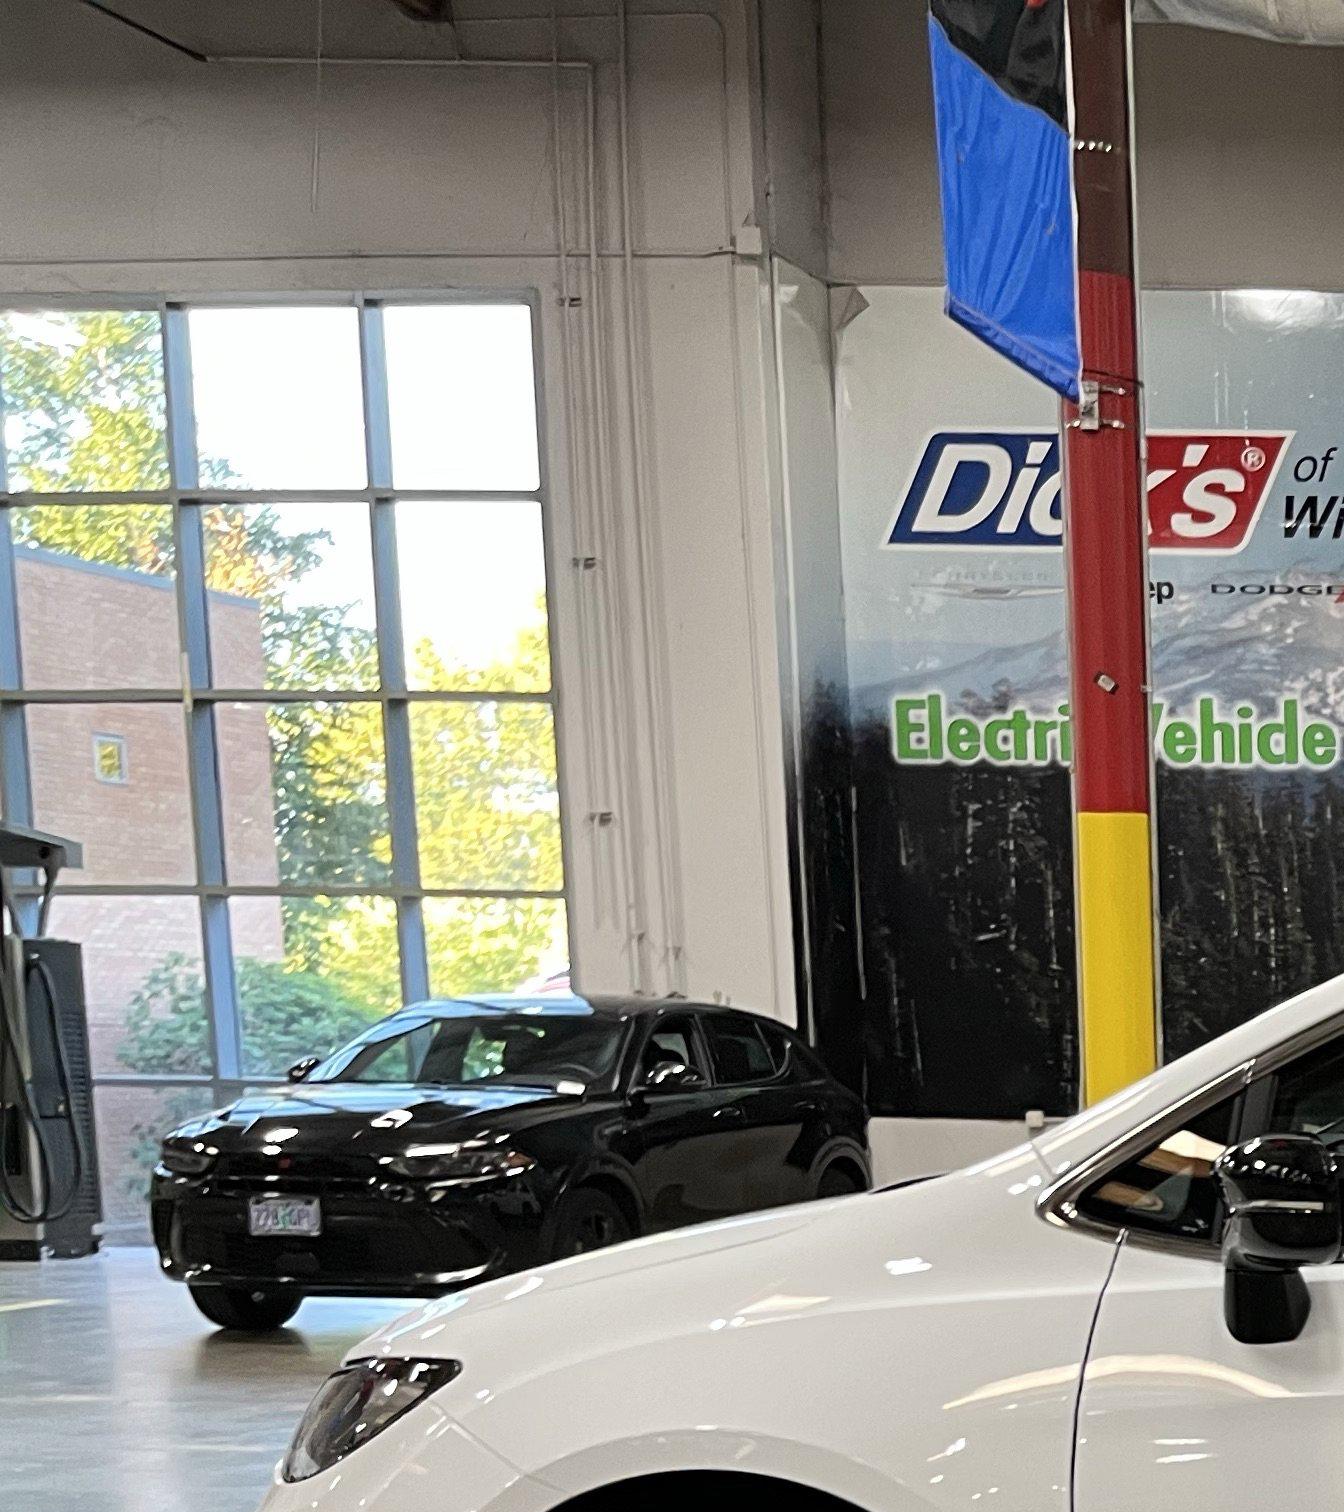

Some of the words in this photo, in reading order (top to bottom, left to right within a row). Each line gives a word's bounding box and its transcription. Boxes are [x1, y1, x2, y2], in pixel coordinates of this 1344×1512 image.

[1294, 447, 1338, 483] of
[895, 693, 1071, 761] Electri
[1152, 698, 1337, 764] ehicle
